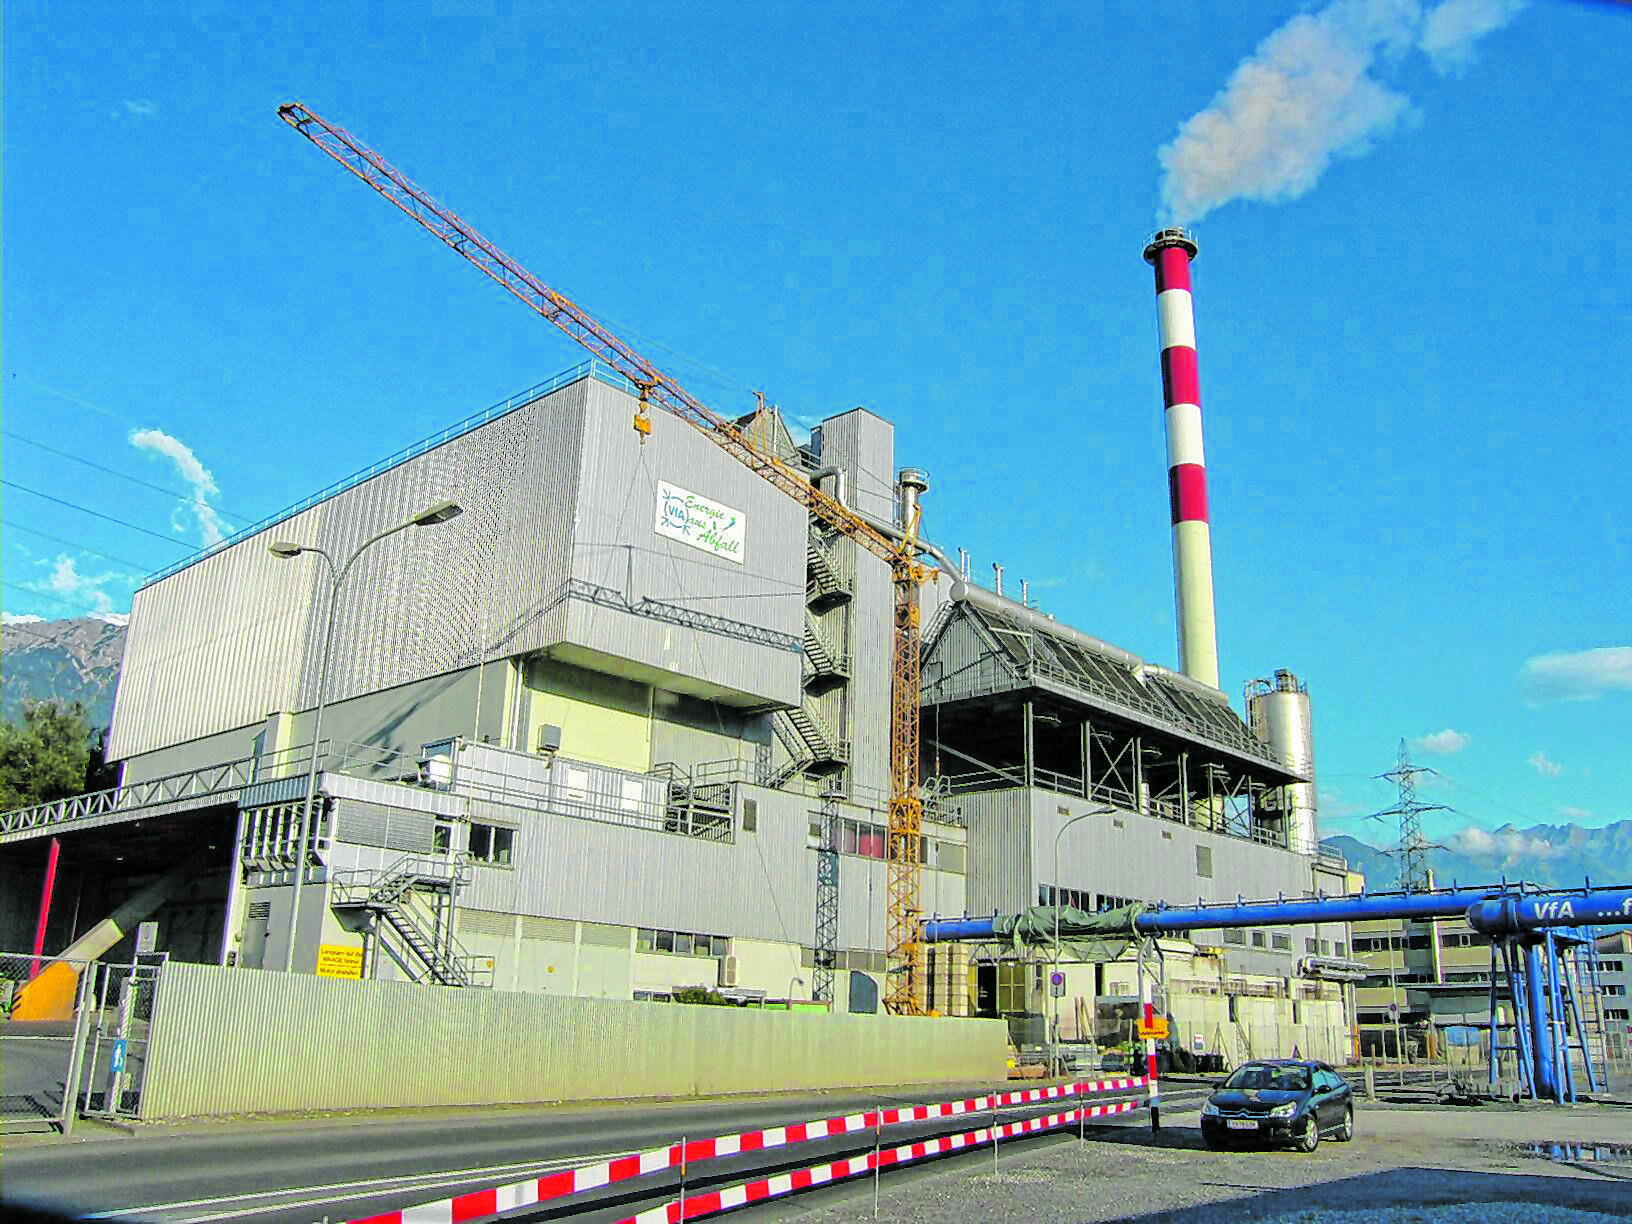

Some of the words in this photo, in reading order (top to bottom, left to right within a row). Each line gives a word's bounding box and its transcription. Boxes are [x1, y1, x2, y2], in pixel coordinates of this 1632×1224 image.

[668, 504, 685, 522] VIA
[684, 495, 725, 520] Energie
[688, 517, 706, 529] aus
[696, 529, 740, 554] Abfall
[1533, 900, 1575, 920] VfA
